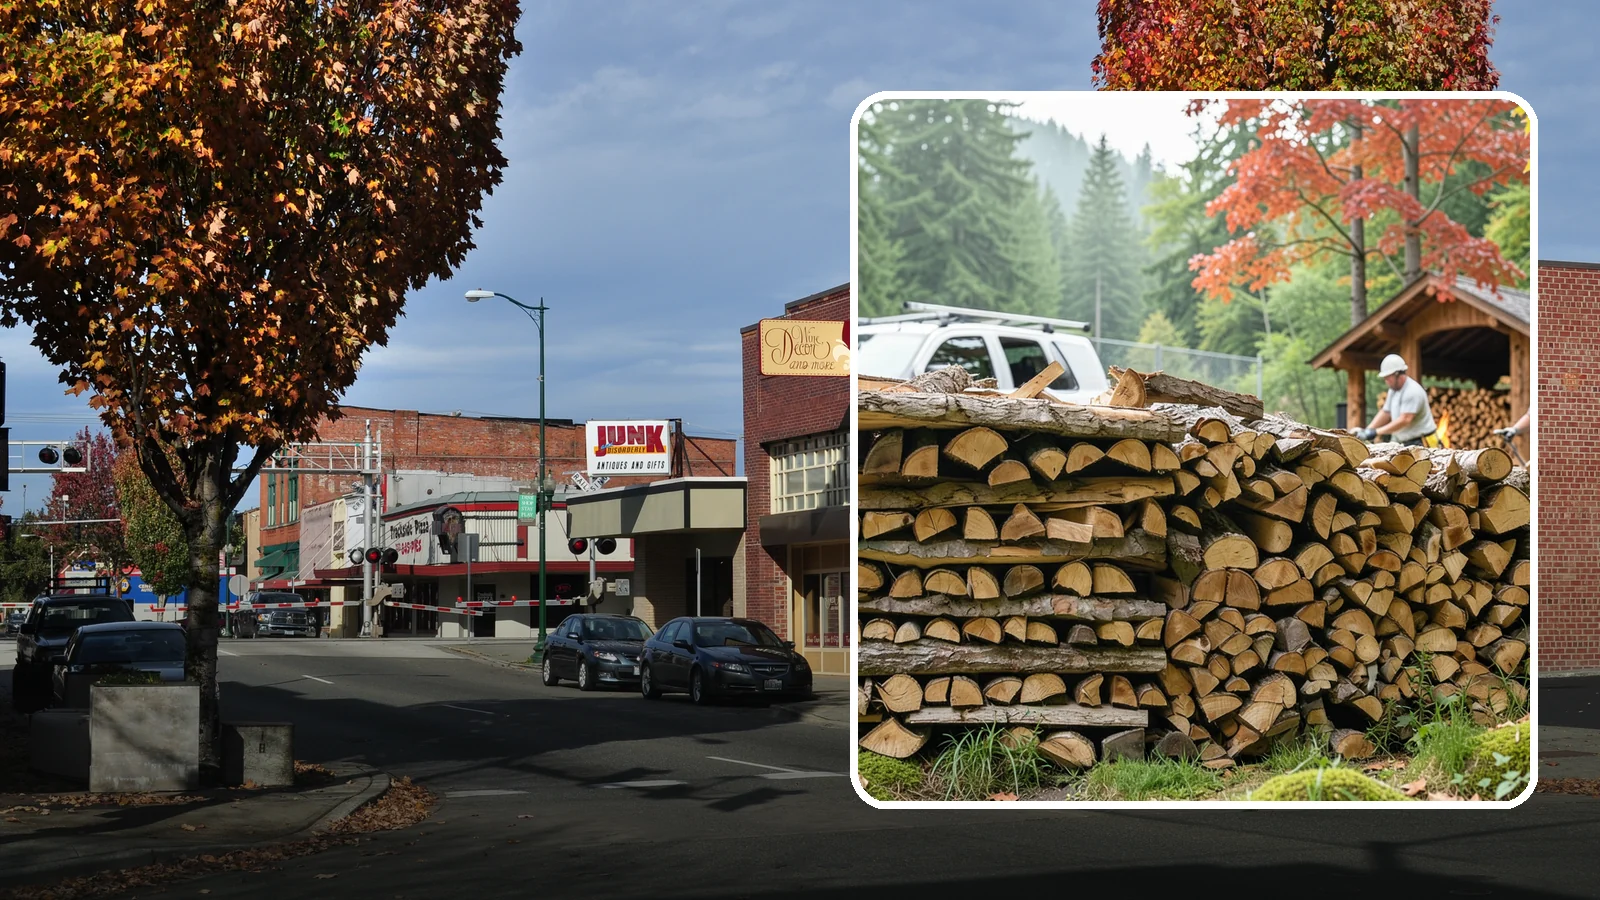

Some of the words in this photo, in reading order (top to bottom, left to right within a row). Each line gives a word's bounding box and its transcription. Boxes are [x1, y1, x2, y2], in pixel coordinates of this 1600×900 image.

[595, 425, 665, 457] JUNK
[607, 446, 646, 454] DISORDERLY
[597, 461, 628, 470] ANTIQUES
[631, 461, 644, 470] AND
[646, 461, 666, 469] GIFTS
[573, 473, 589, 492] RAIL
[352, 499, 364, 511] CRO
[414, 519, 429, 535] Pizza
